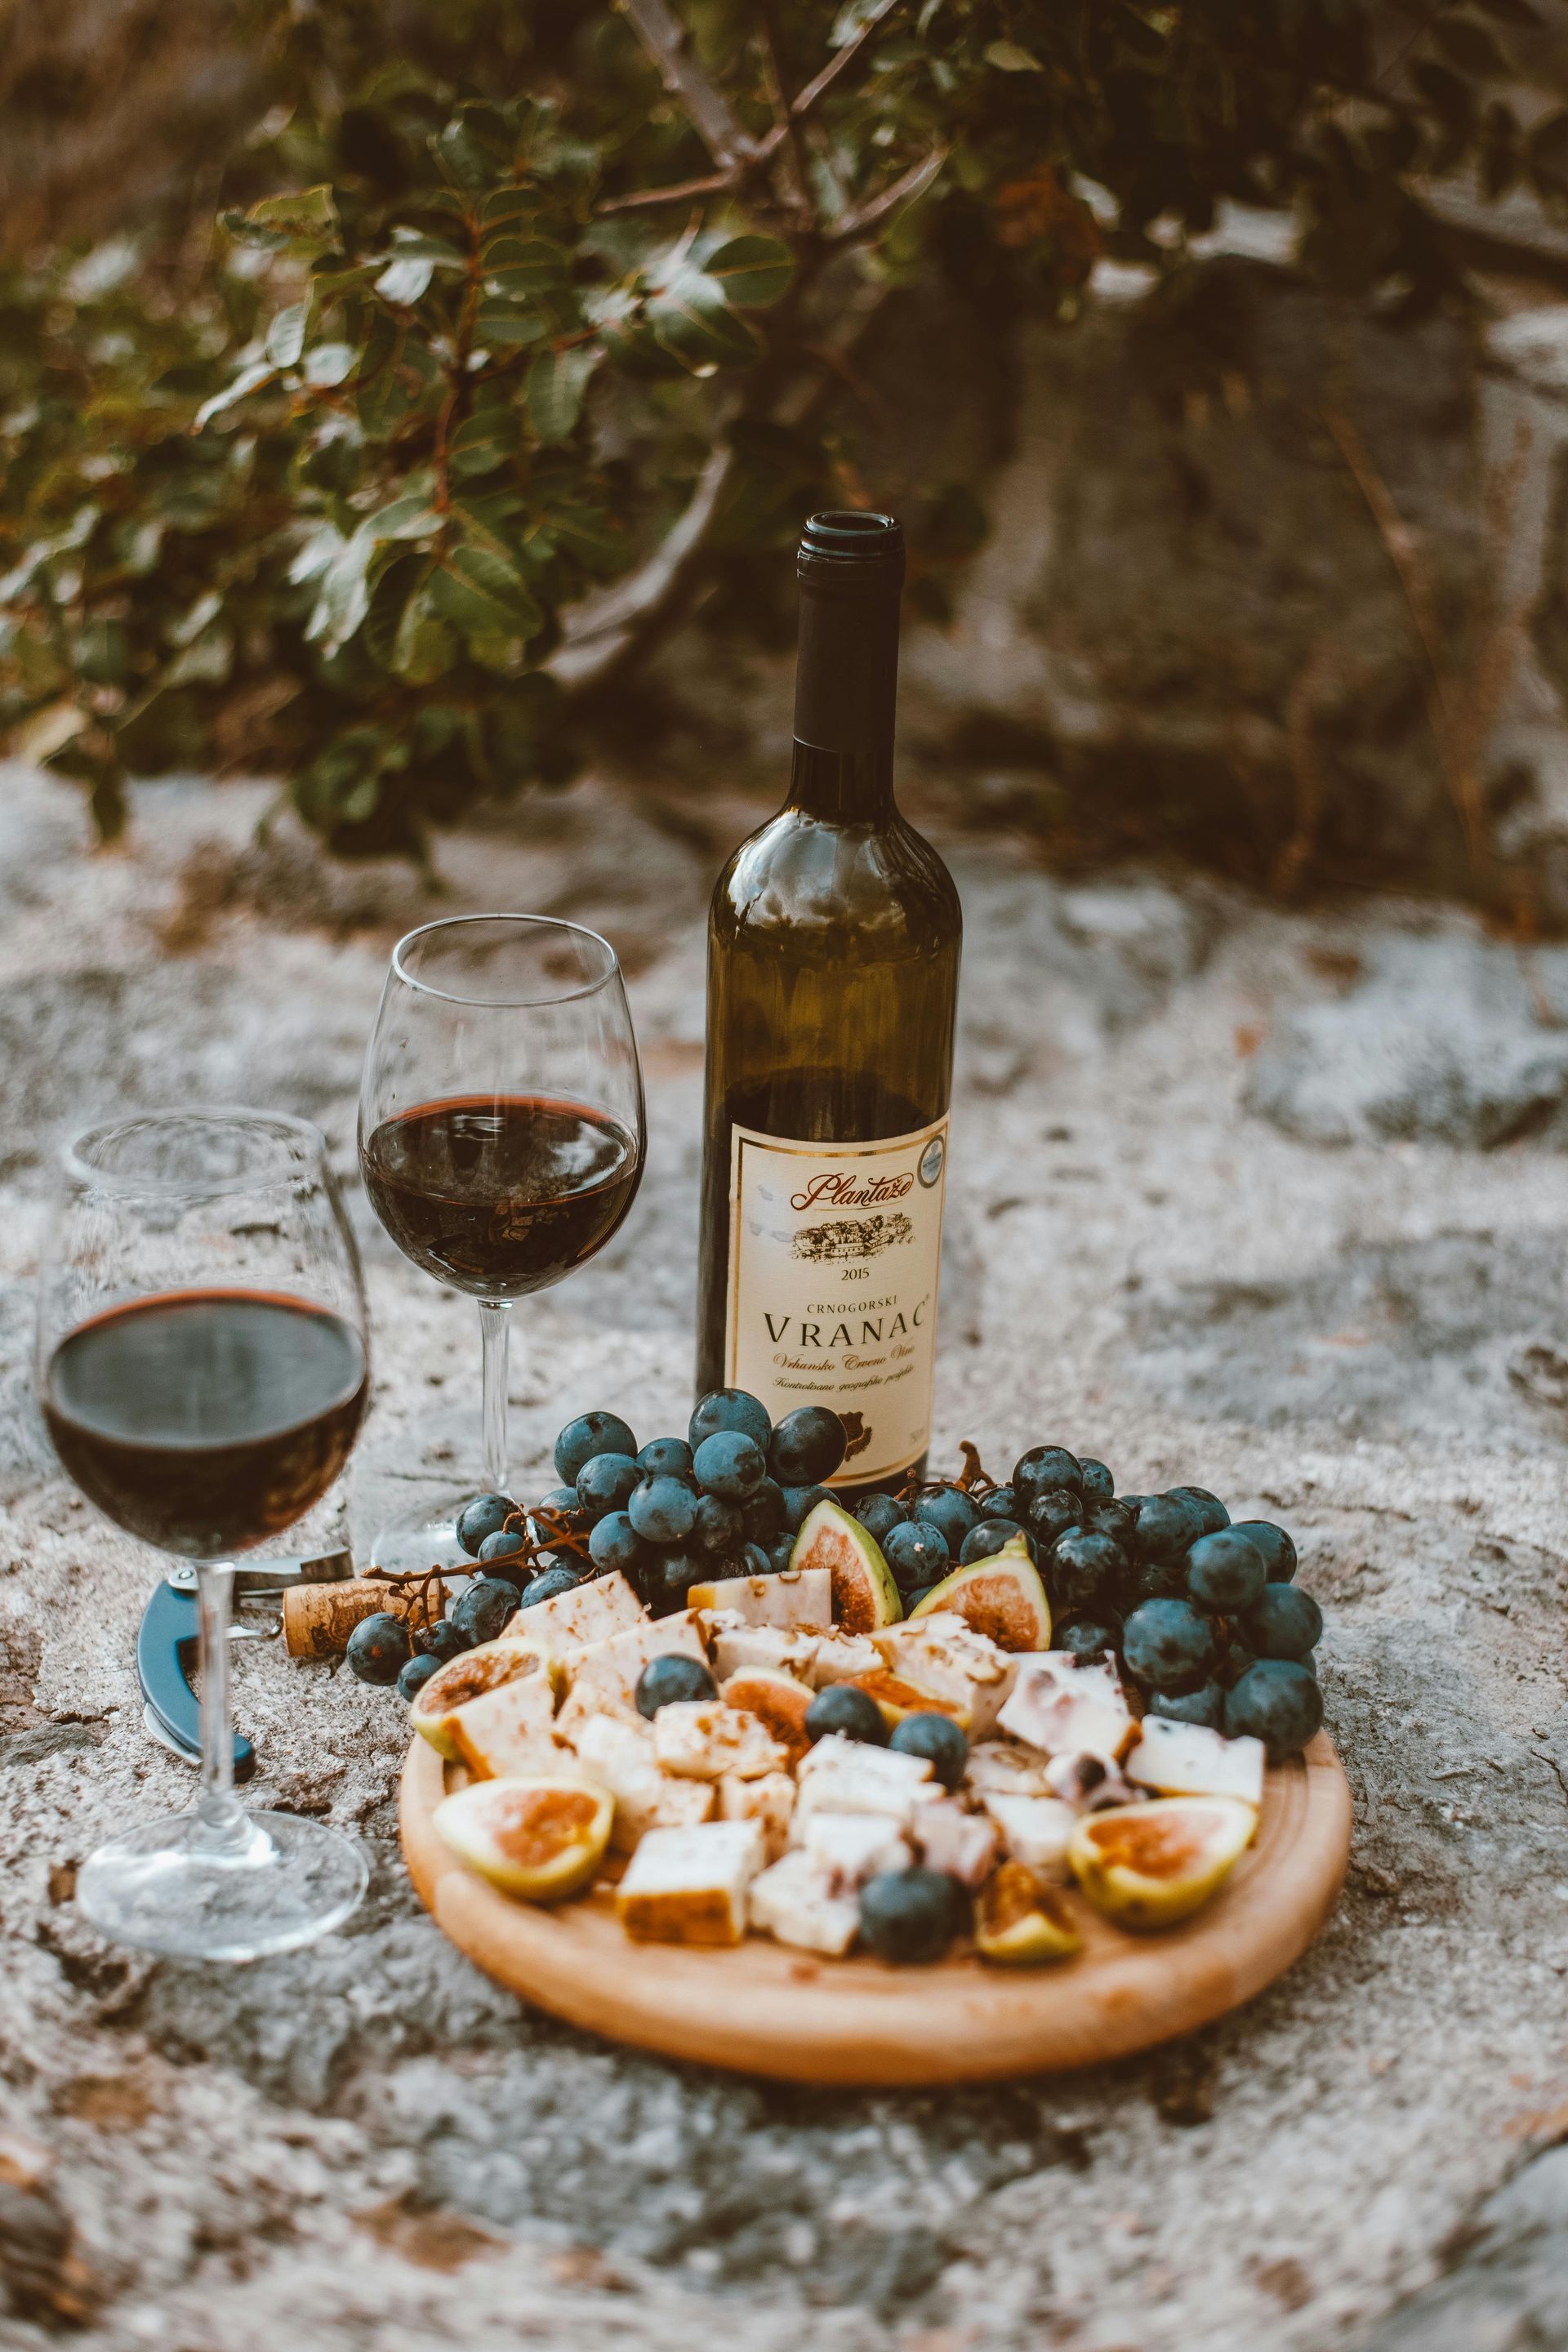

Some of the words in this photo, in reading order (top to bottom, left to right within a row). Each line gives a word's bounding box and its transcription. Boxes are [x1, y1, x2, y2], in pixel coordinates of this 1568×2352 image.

[791, 1173, 914, 1210] Plantaže
[841, 1267, 870, 1281] 2015
[807, 1295, 898, 1314] CRNOGORSKI
[764, 1300, 925, 1348] VRANAC
[773, 1352, 836, 1371] Vrhunsko
[842, 1353, 887, 1370] Crveno
[890, 1339, 915, 1360] Vino
[773, 1377, 835, 1391] Kontrolisano
